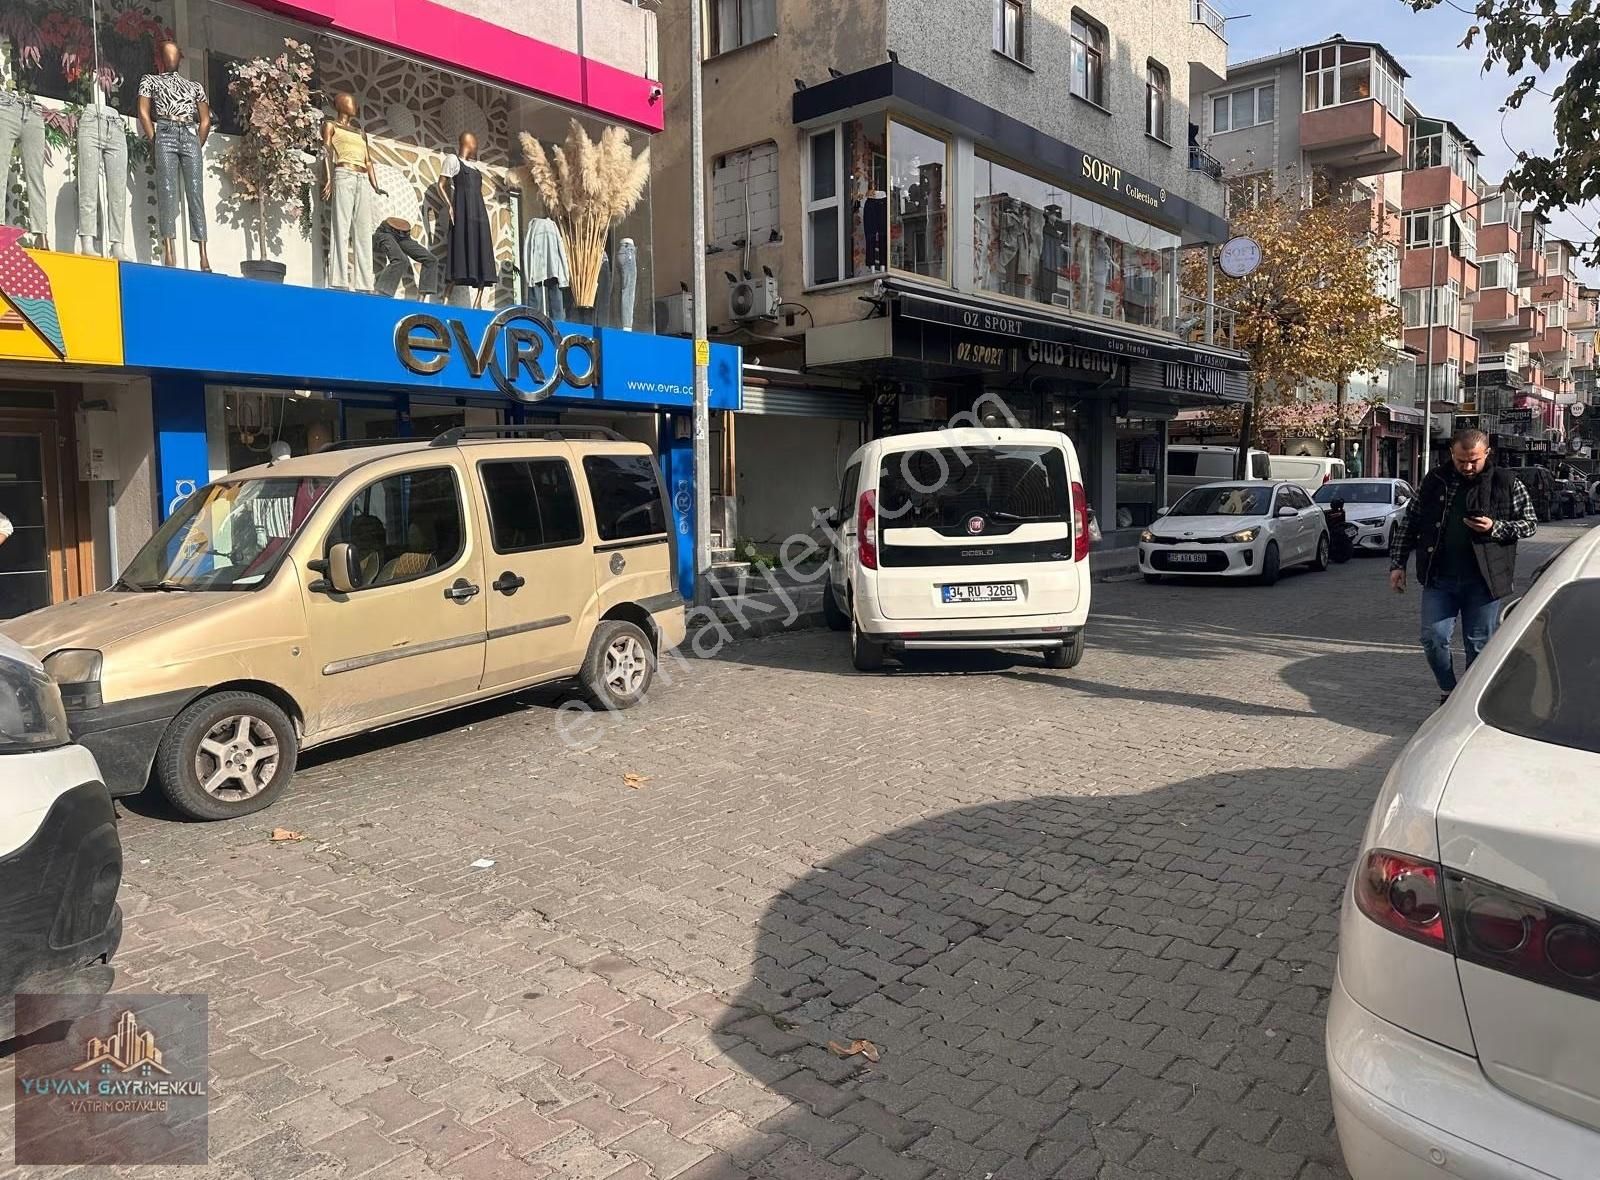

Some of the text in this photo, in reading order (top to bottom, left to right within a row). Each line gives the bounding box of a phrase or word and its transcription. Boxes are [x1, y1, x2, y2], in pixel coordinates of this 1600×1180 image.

[1082, 154, 1121, 191] SOFT
[1125, 183, 1158, 208] Collection
[963, 311, 1023, 335] OZ SPORT
[957, 342, 1004, 366] OZ SPORT
[1186, 420, 1203, 428] THE
[1531, 441, 1547, 452] Lady
[950, 585, 1013, 598] 34 RU 3268
